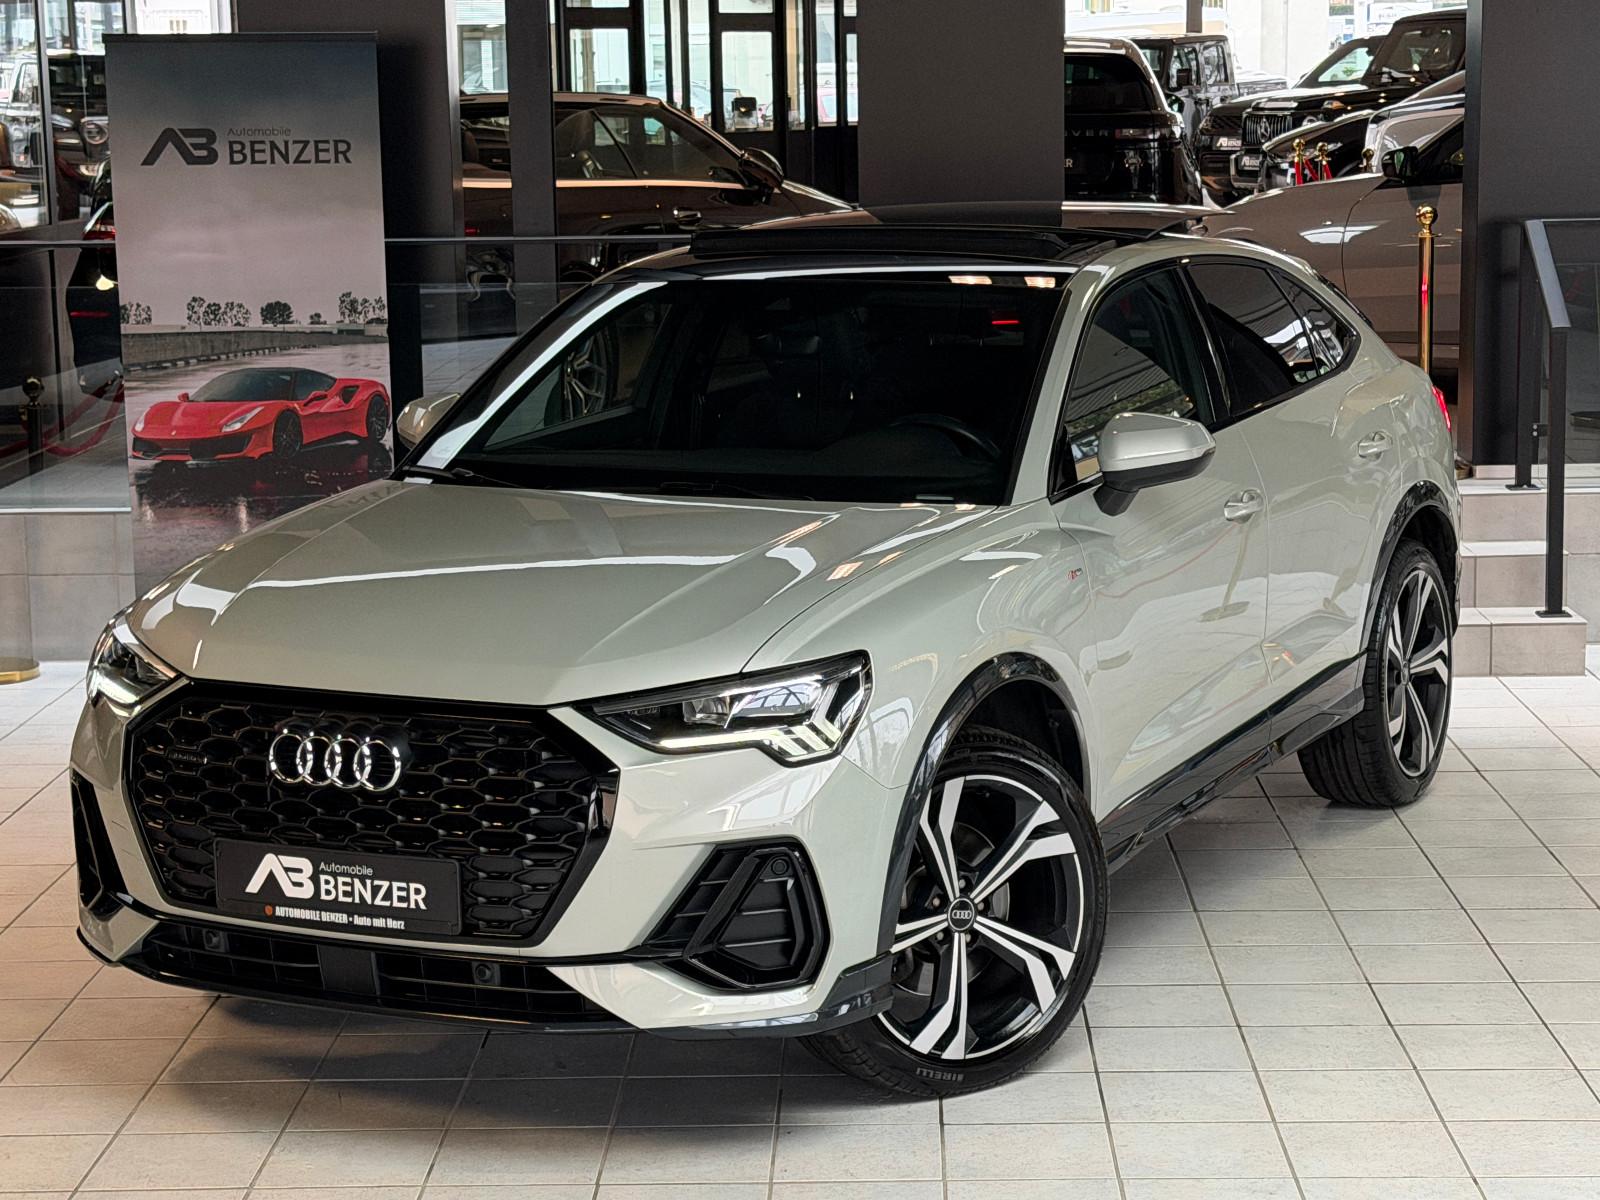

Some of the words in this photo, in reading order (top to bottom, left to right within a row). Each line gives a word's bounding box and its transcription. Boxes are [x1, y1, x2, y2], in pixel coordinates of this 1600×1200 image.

[227, 127, 292, 137] Automobile
[1064, 129, 1108, 137] VER
[140, 127, 219, 166] AB
[228, 139, 352, 165] BENZER
[244, 852, 315, 900] AB
[319, 861, 374, 876] Automobile
[319, 875, 428, 910] BENZER
[275, 905, 321, 921] AUTOMOBILE
[321, 911, 348, 924] BENZER
[354, 914, 372, 926] Auto
[372, 917, 386, 927] mit
[386, 918, 405, 930] Herz
